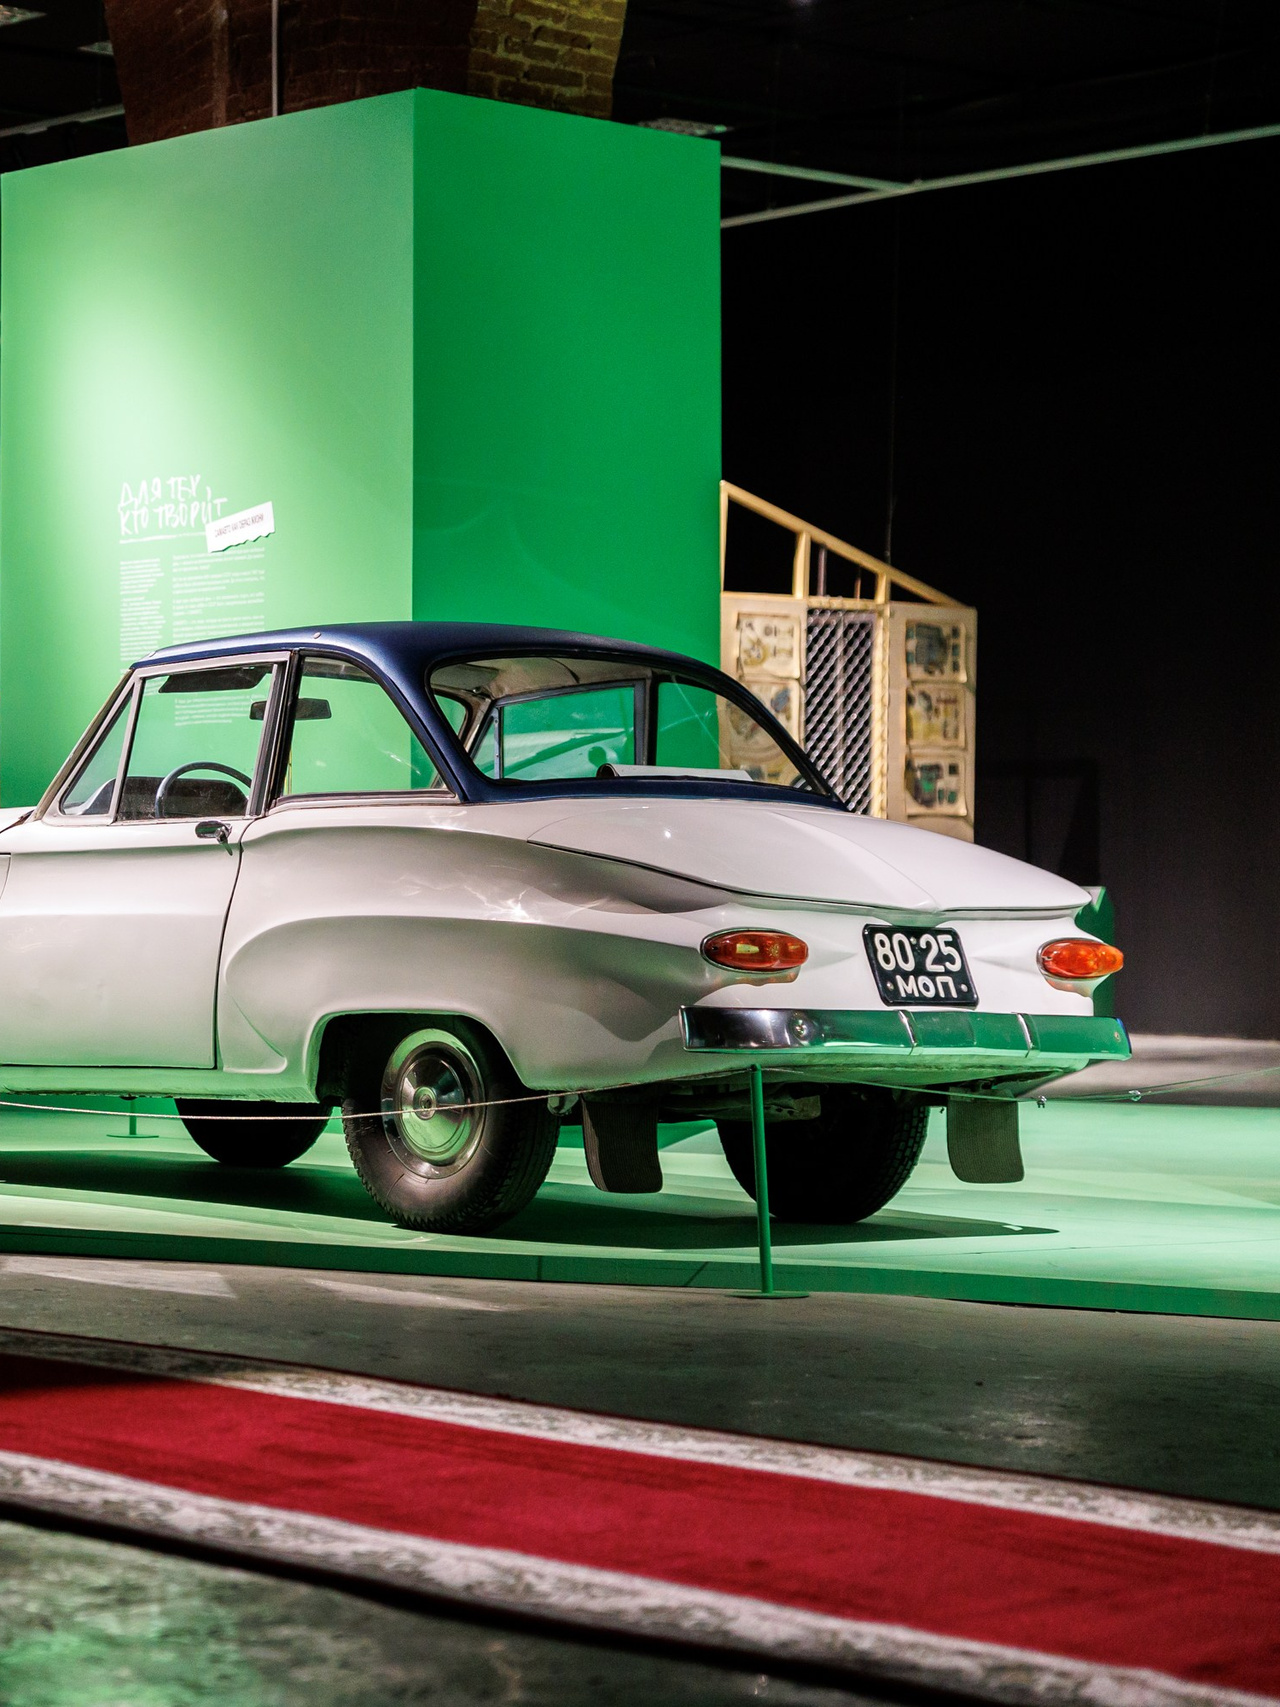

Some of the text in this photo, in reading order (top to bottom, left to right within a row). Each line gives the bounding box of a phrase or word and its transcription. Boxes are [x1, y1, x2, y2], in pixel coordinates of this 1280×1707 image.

[118, 504, 149, 536] КТО
[153, 498, 228, 529] ТВОРИТ
[895, 975, 958, 998] МОП
